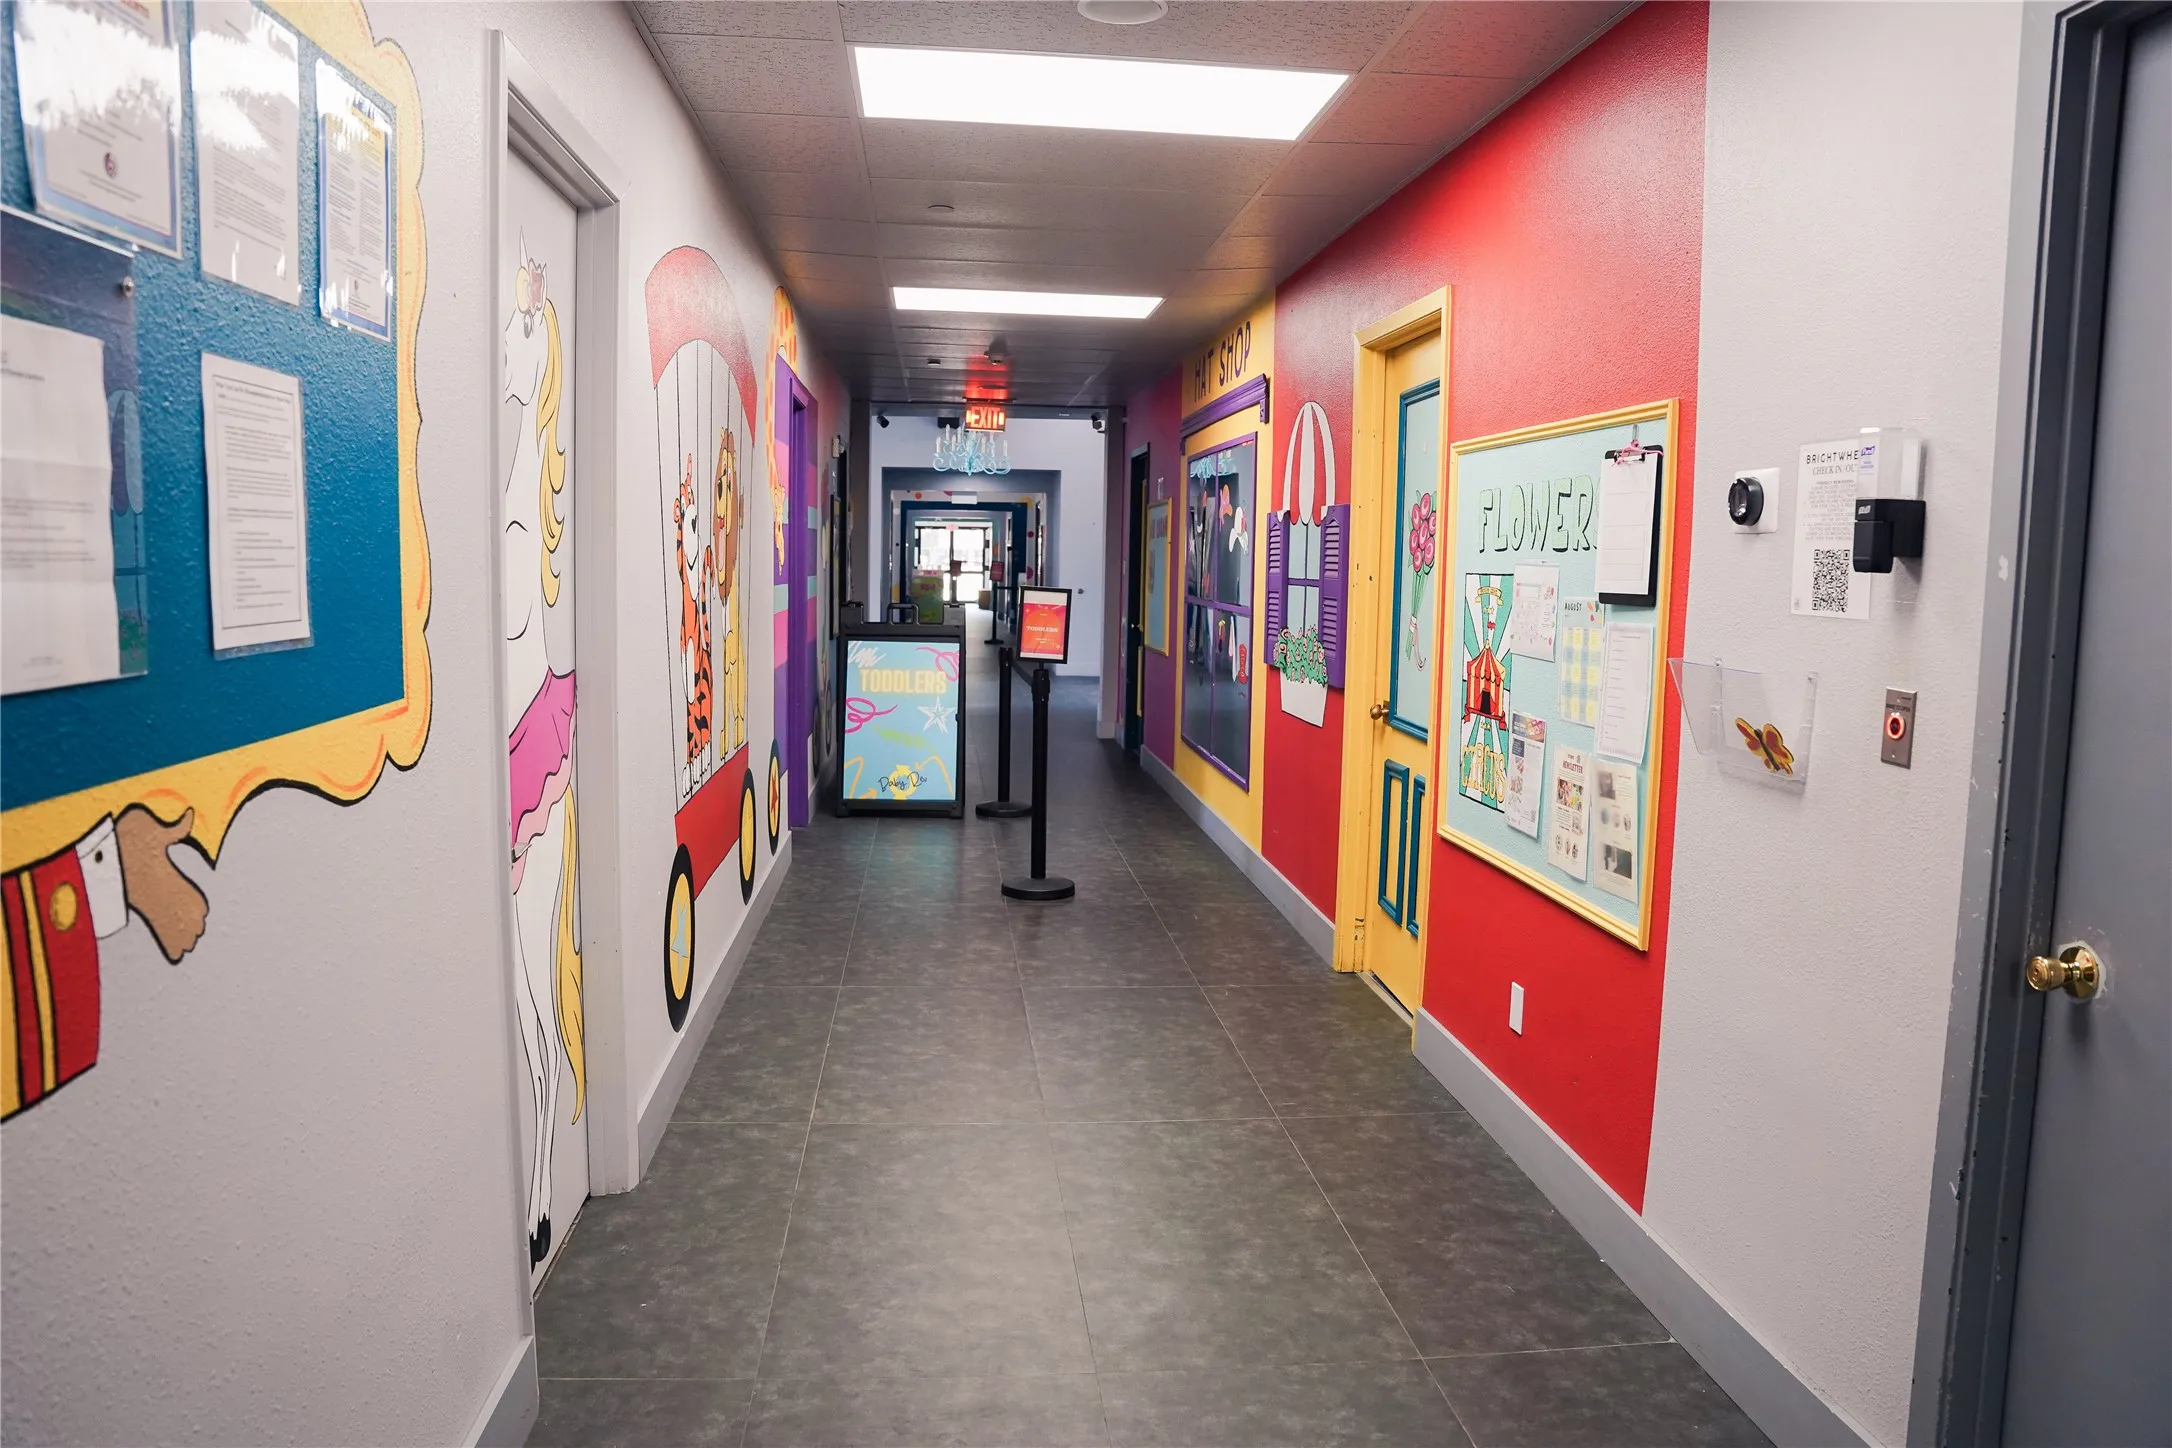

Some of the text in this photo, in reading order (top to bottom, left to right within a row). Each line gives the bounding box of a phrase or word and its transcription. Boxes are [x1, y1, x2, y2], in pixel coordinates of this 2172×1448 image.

[1194, 321, 1251, 403] HAT SHOP
[970, 406, 1000, 429] EXIT
[1806, 449, 1859, 465] BRIGHTWHE
[1812, 466, 1834, 476] CHECK
[1478, 474, 1600, 554] FLOWER
[1564, 601, 1582, 612] AUGUST
[860, 668, 947, 694] TODDLERS
